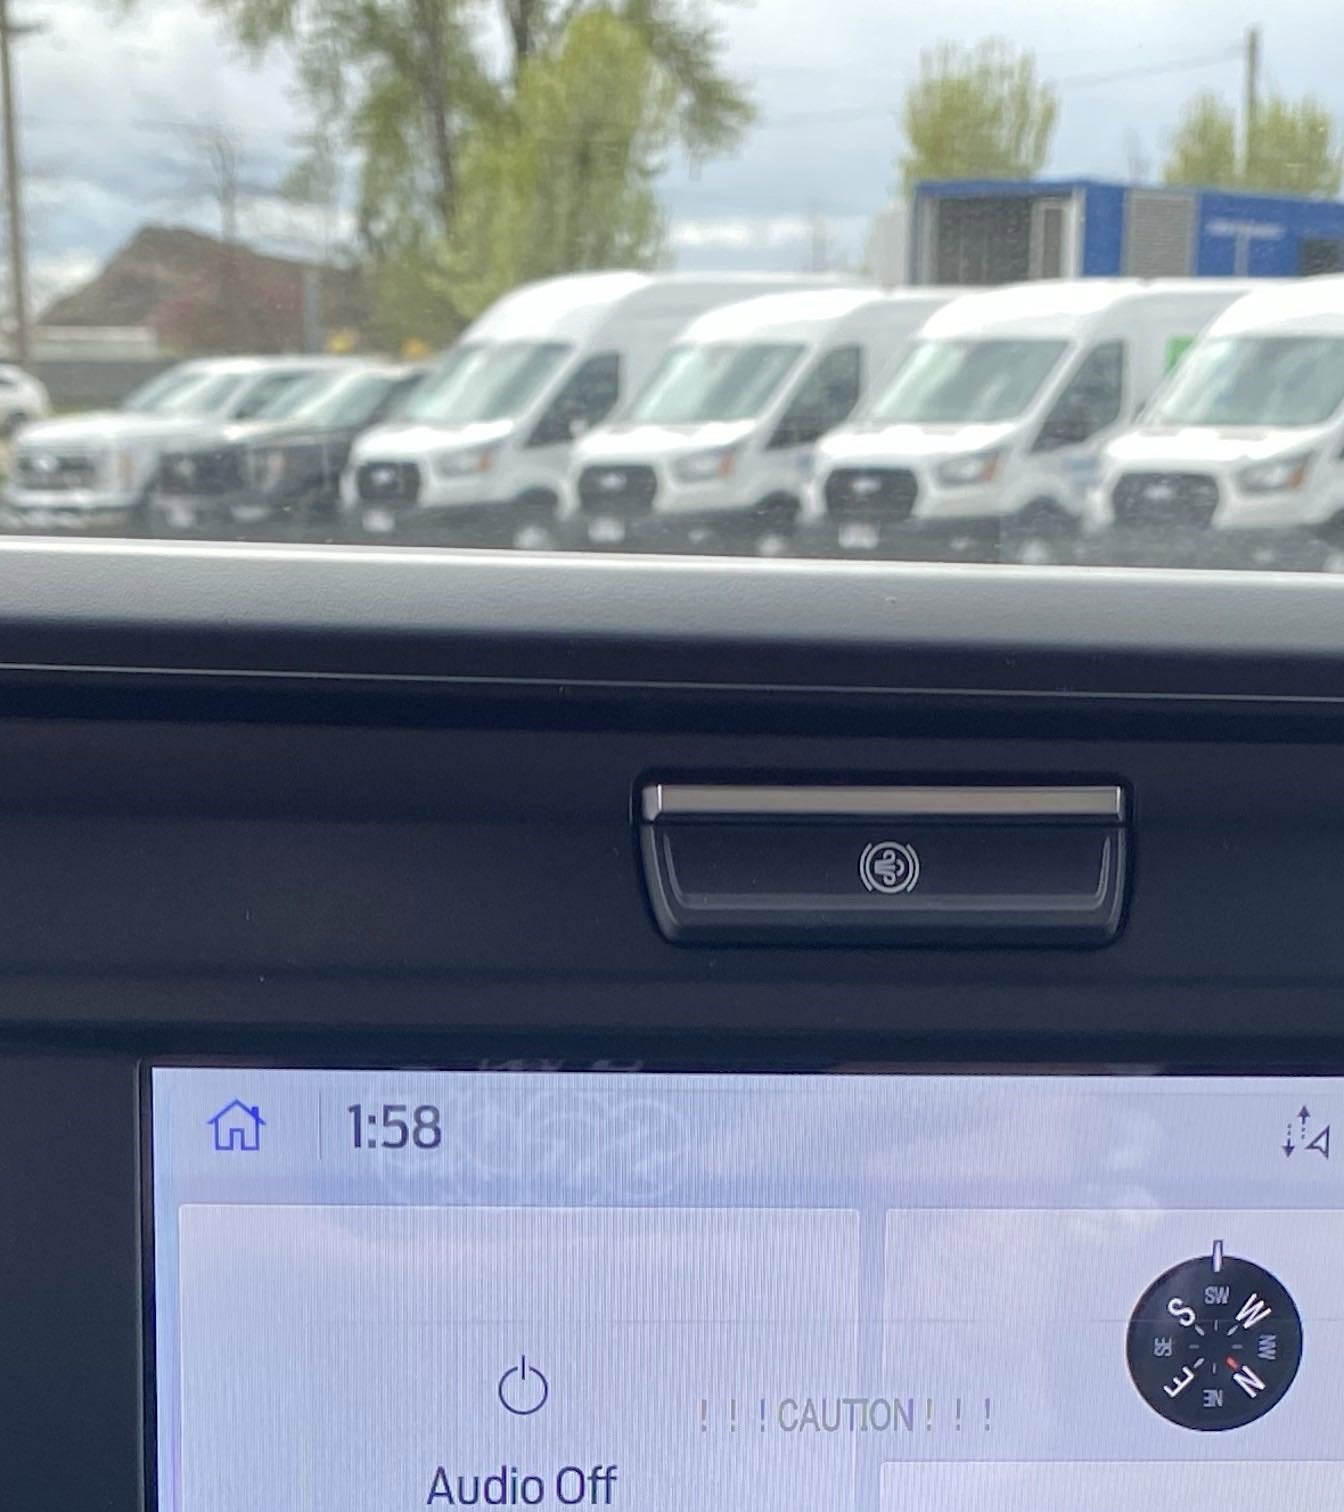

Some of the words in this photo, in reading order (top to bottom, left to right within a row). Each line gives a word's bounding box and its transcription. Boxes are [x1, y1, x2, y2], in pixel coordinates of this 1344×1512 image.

[347, 1104, 442, 1149] 1:58
[426, 1465, 544, 1505] Audio
[556, 1465, 618, 1505] Off
